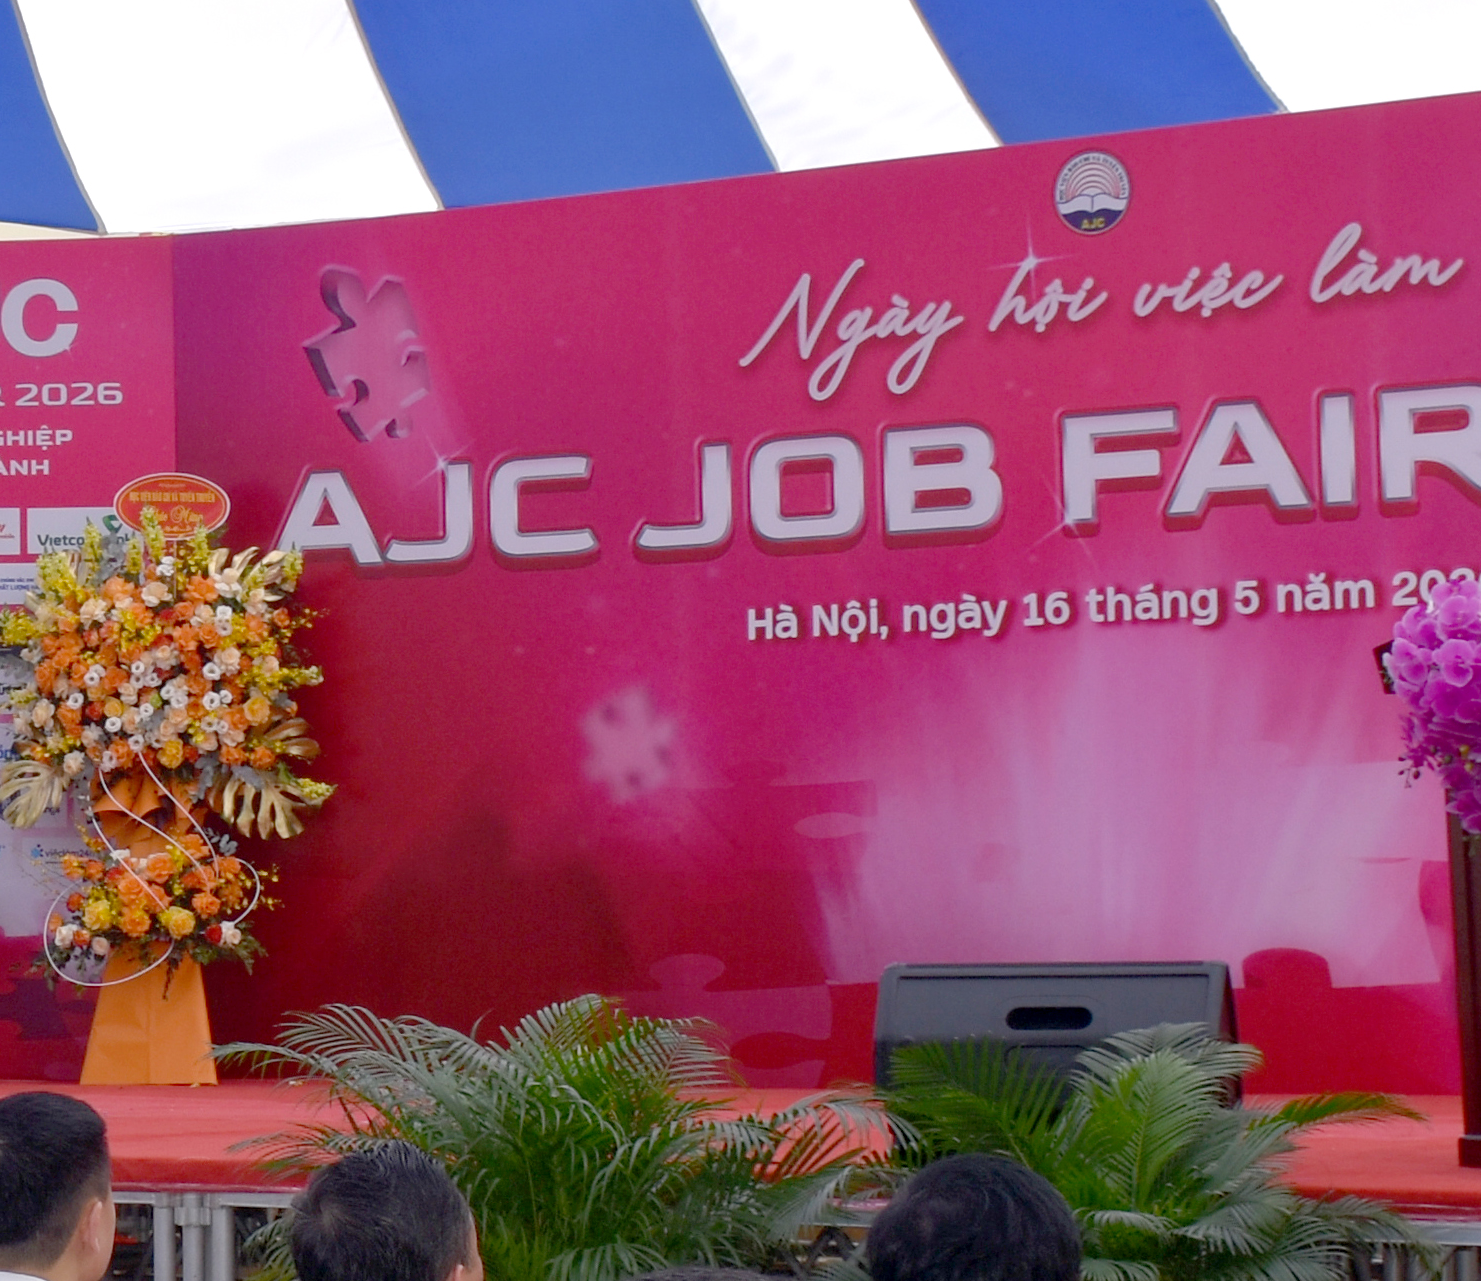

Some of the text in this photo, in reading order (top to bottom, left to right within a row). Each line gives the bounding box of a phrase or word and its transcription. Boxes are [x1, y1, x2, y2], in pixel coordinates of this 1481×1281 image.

[740, 222, 1464, 402] Ngày hội việc làm
[15, 382, 124, 406] 2026
[281, 452, 598, 568] AJC
[637, 421, 1005, 551] JOB
[747, 603, 796, 641] Hà
[811, 603, 889, 642] Nội,
[902, 592, 1007, 639] ngày
[1022, 590, 1070, 627] 16
[1086, 583, 1219, 629] tháng
[1235, 580, 1259, 615] 5
[1276, 571, 1376, 613] năm
